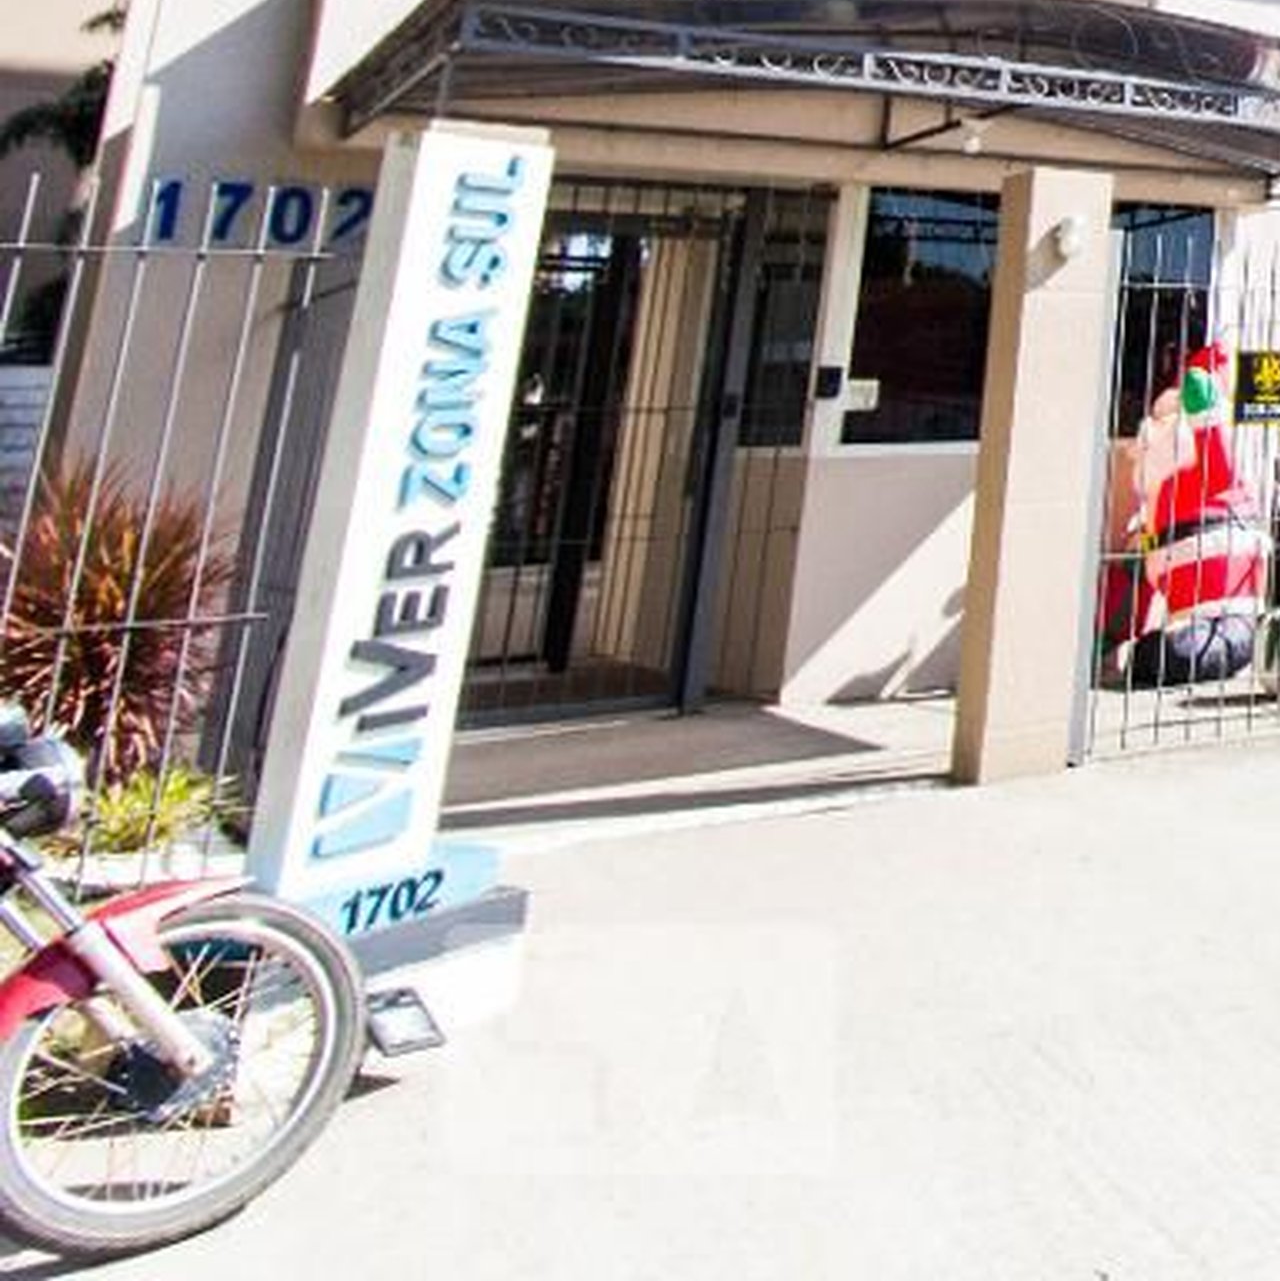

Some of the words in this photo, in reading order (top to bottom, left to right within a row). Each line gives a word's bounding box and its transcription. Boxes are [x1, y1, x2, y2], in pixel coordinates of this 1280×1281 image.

[152, 180, 375, 245] 1702
[437, 155, 523, 290] SUL
[396, 309, 496, 512] ZONA
[341, 868, 444, 935] 1702
